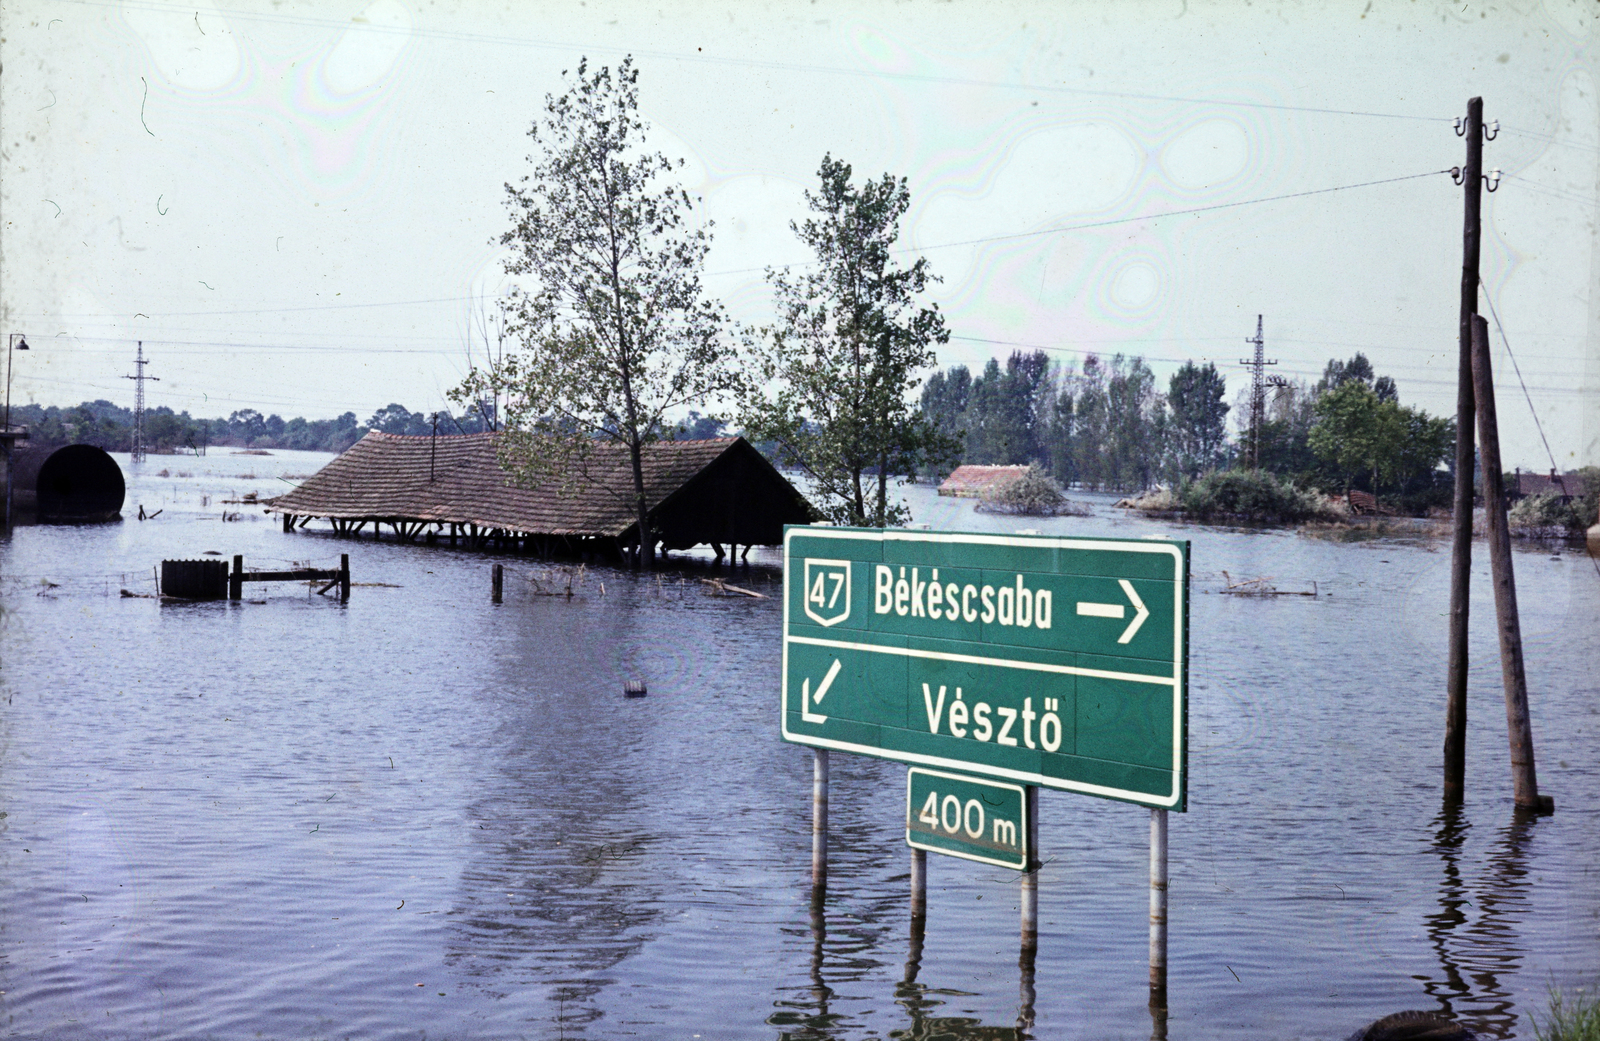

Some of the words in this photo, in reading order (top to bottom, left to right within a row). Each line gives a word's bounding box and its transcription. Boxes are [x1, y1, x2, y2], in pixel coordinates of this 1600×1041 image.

[810, 573, 844, 608] 47
[875, 565, 1052, 629] Békéscsaba
[919, 791, 984, 839] 400
[994, 817, 1016, 846] m
